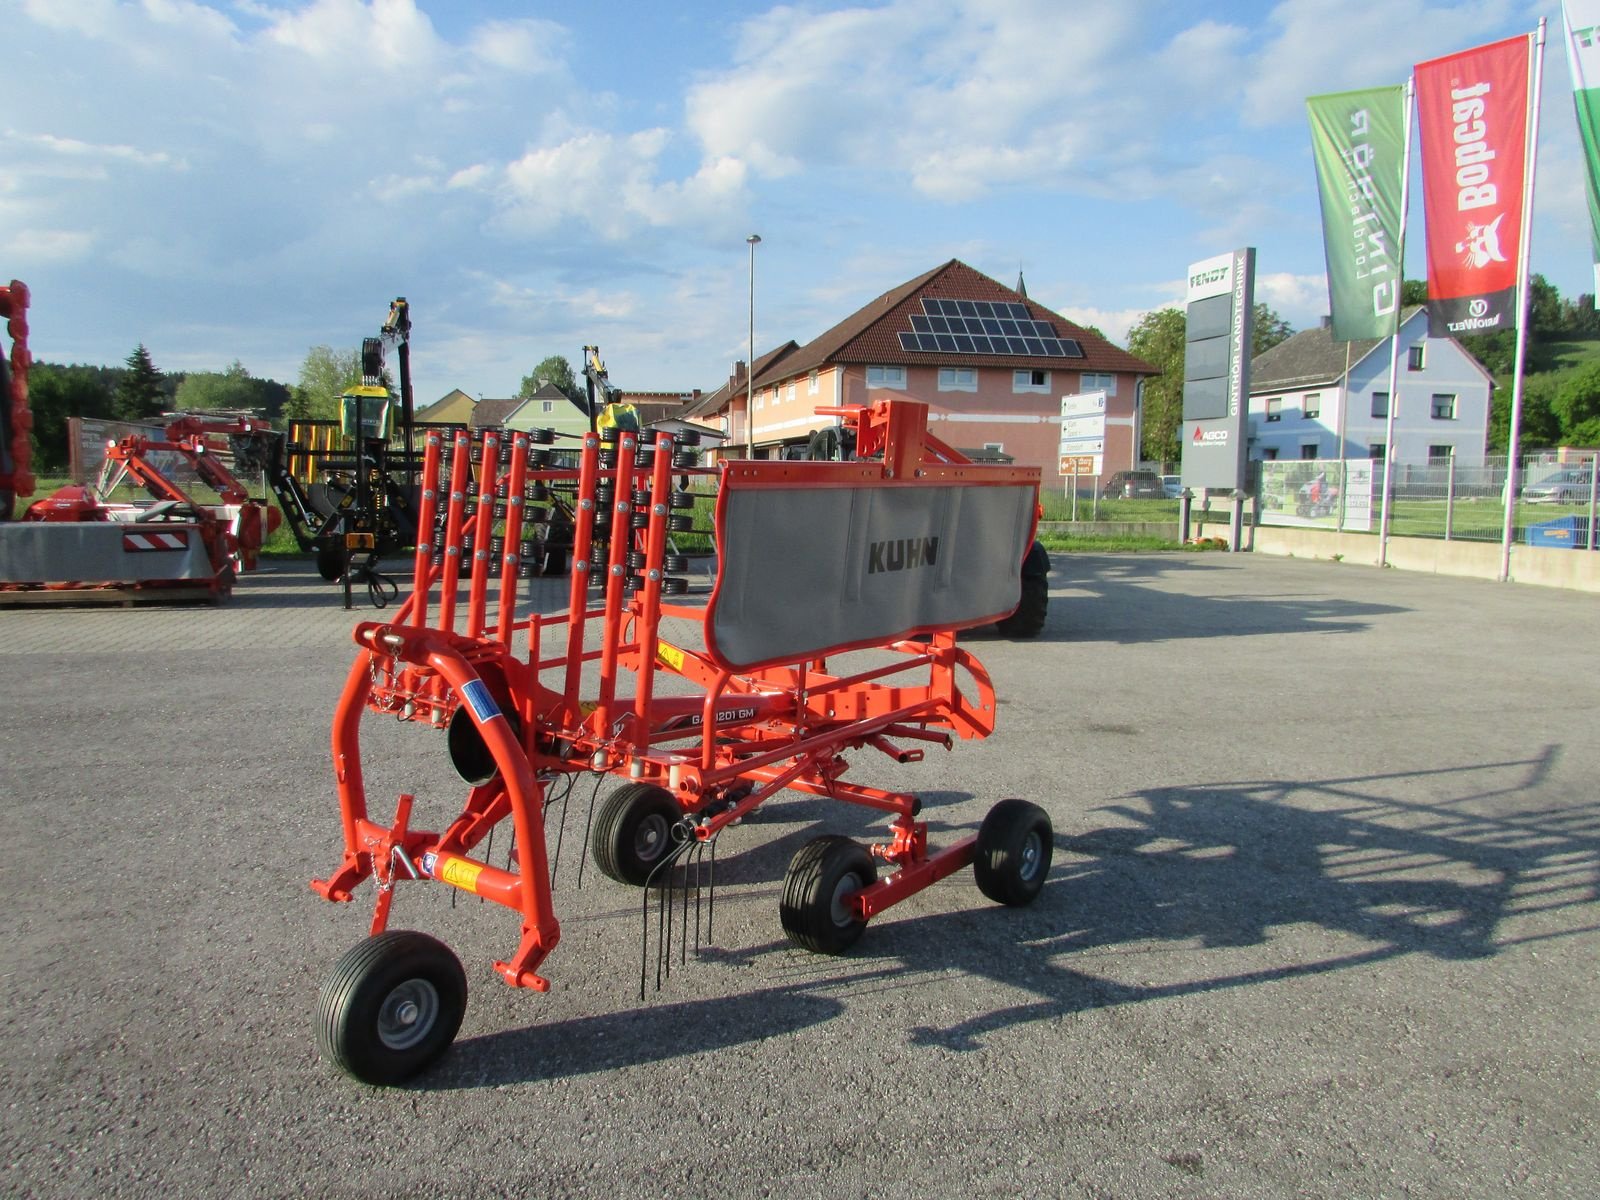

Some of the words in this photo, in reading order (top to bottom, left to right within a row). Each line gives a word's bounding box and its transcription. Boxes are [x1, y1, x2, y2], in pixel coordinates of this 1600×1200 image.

[1190, 267, 1229, 288] FENDT
[1233, 256, 1245, 353] LANDTECHNIK
[1230, 355, 1241, 416] GINTHÖR
[1202, 430, 1228, 440] AGCO
[868, 537, 939, 574] KUHN
[738, 708, 754, 719] GM
